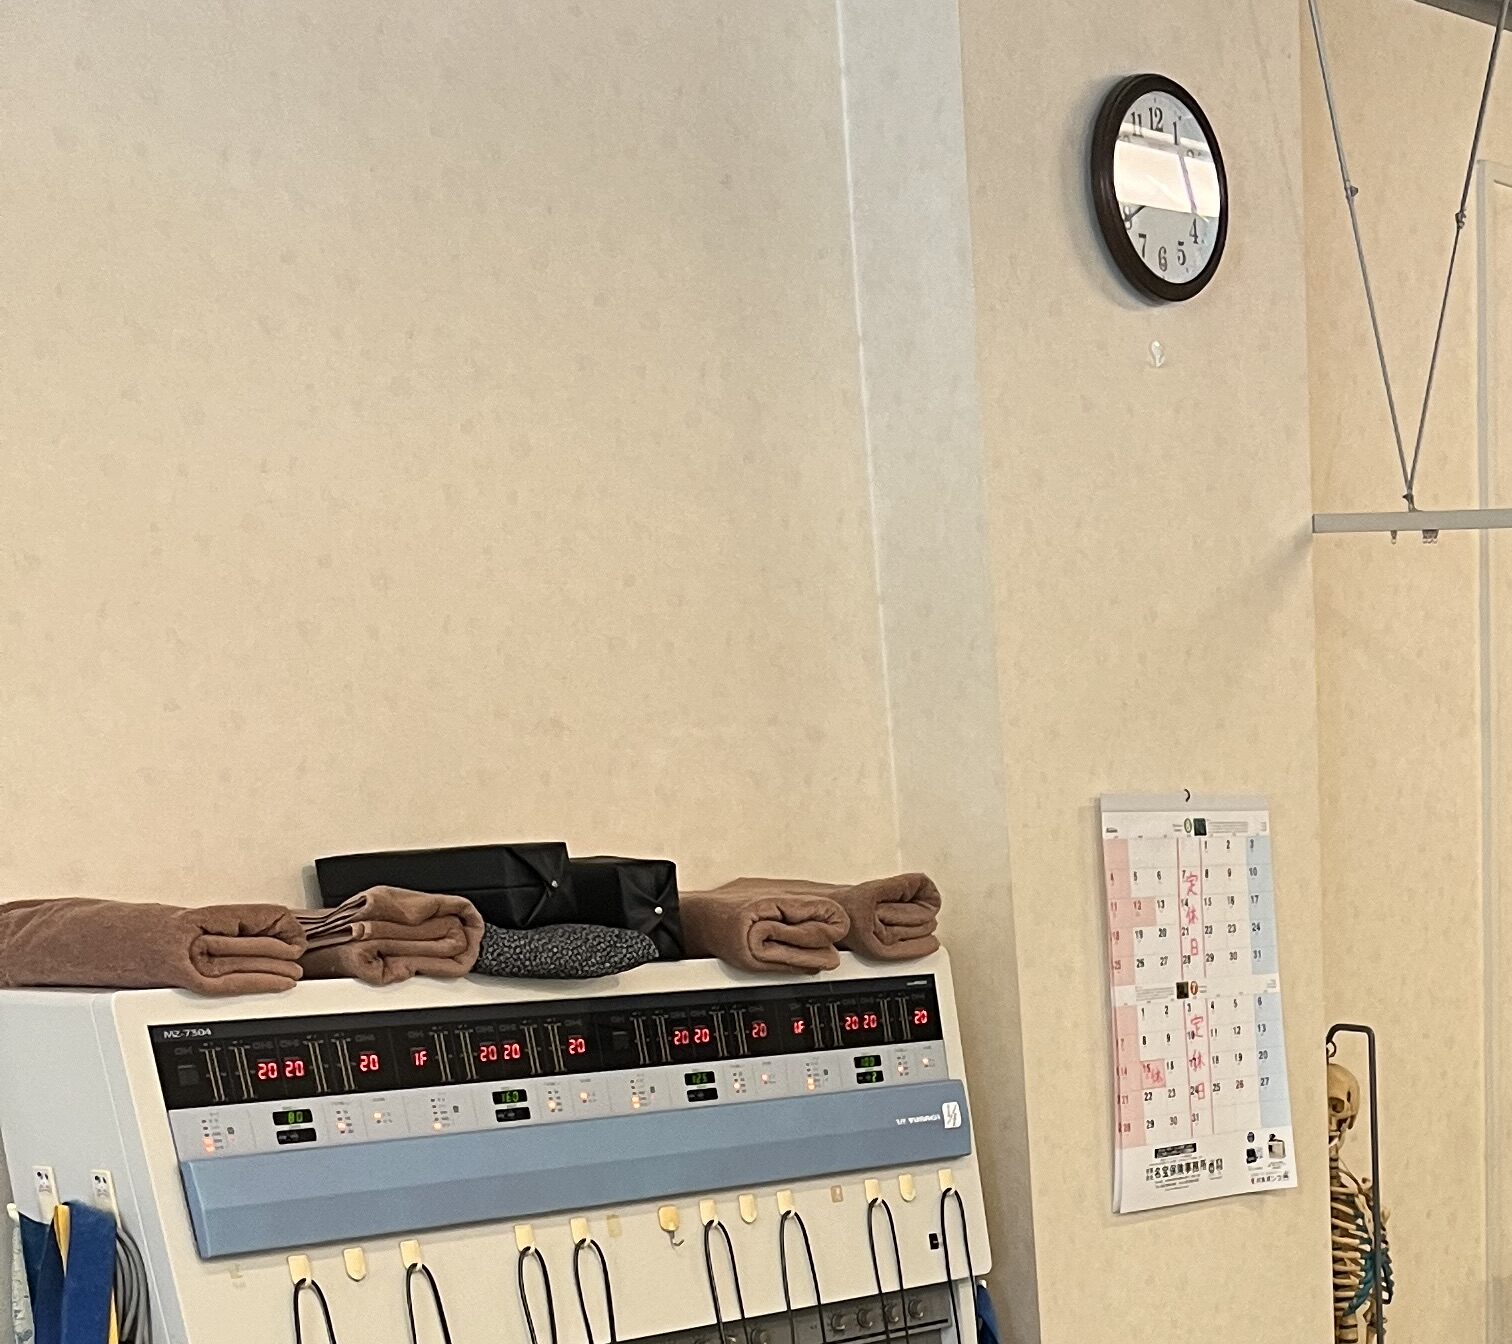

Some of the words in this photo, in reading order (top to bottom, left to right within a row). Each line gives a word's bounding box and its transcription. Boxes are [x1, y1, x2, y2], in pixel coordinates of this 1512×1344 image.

[1131, 112, 1144, 138] 11
[1149, 107, 1163, 132] 12
[1173, 121, 1179, 145] 1
[1189, 218, 1199, 244] 4
[1138, 233, 1147, 258] 7
[1177, 240, 1186, 265] 5
[1158, 246, 1168, 271] 6
[1253, 950, 1262, 959] 31
[844, 1016, 859, 1030] 20
[863, 1014, 877, 1029] 20
[914, 1010, 928, 1024] 20
[163, 1028, 212, 1039] MZ-7304
[673, 1030, 690, 1045] 20
[694, 1028, 710, 1043] 20
[752, 1023, 767, 1038] 20
[480, 1045, 497, 1061] 20
[503, 1043, 521, 1060] 20
[568, 1038, 586, 1054] 20
[257, 1062, 278, 1080] 20
[285, 1060, 305, 1077] 20
[359, 1054, 379, 1071] 20
